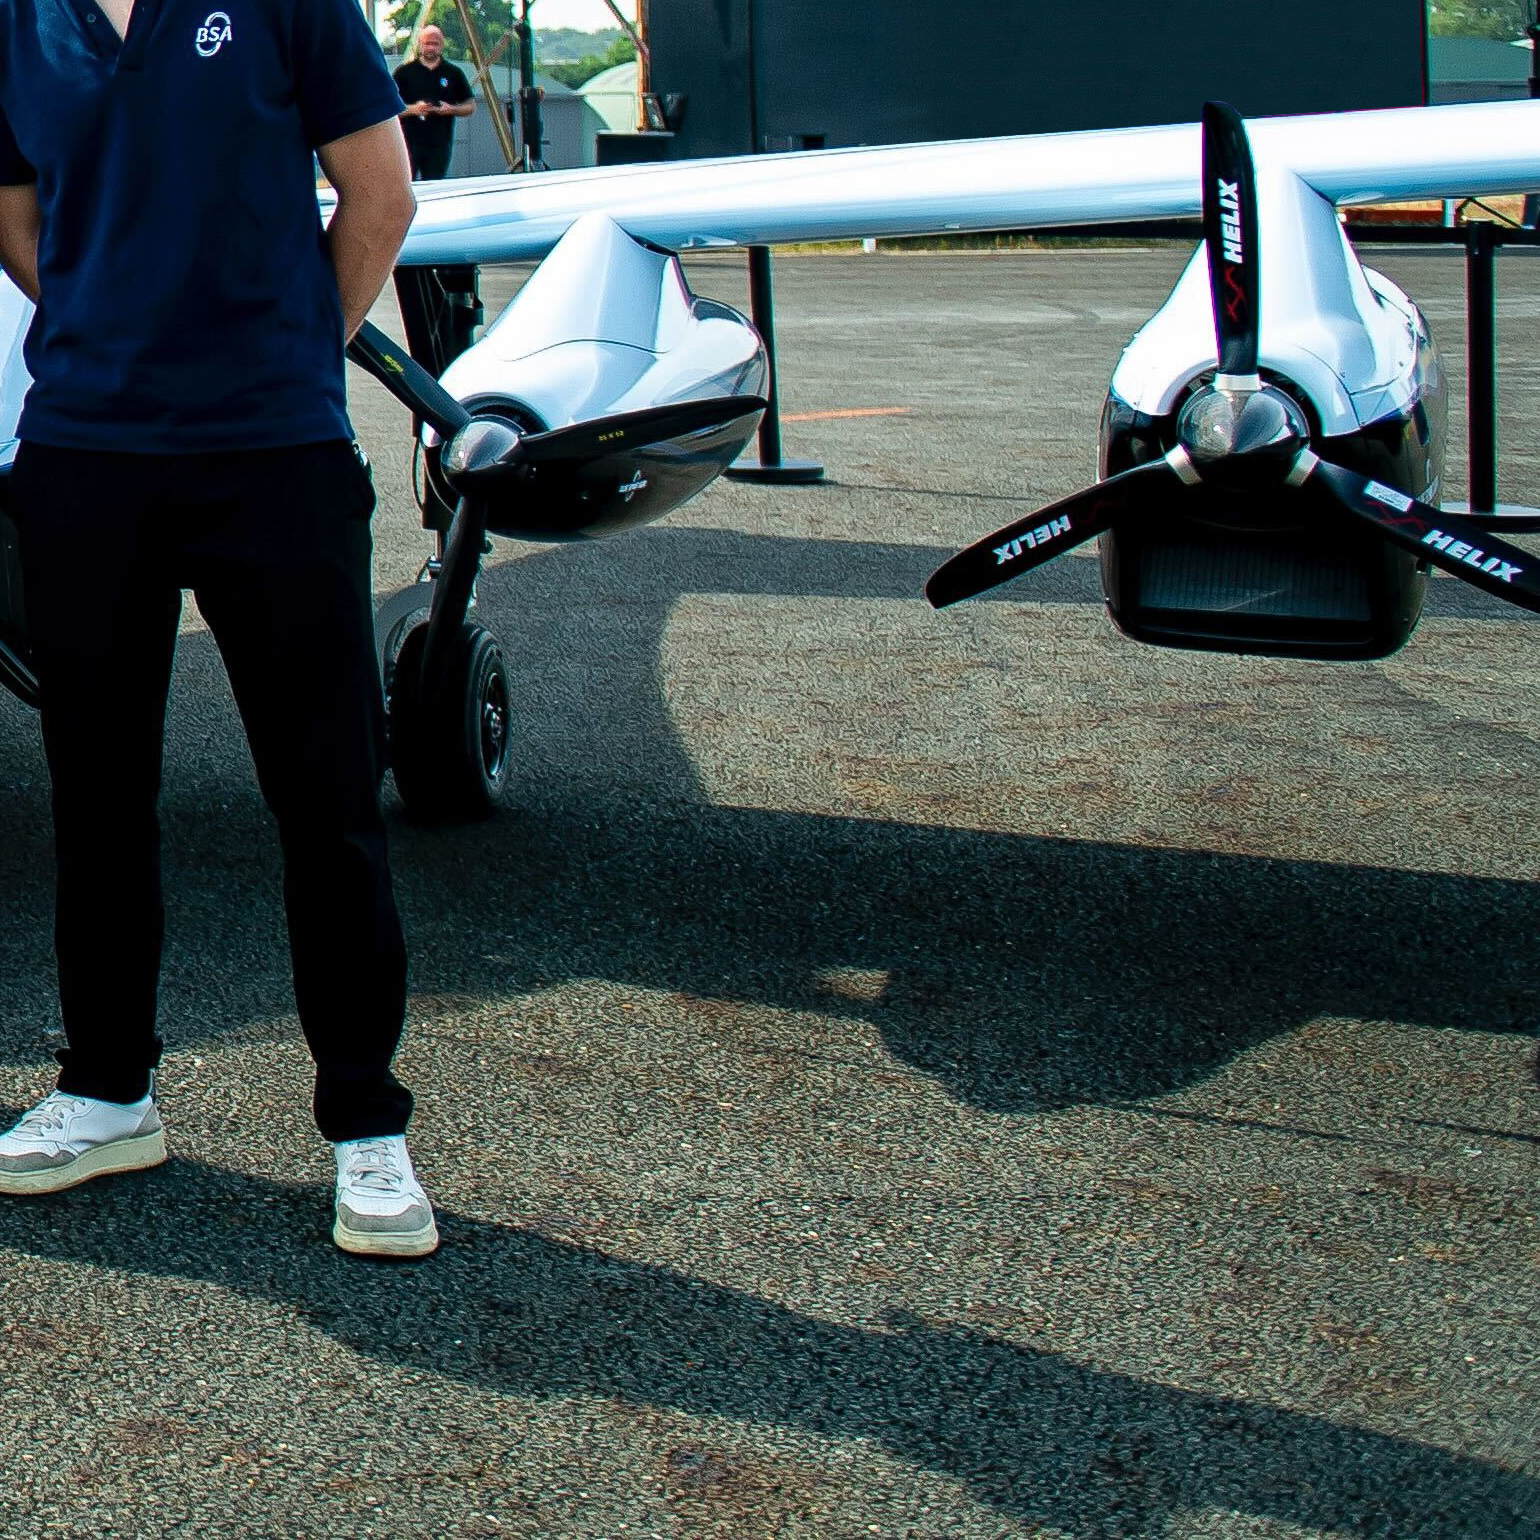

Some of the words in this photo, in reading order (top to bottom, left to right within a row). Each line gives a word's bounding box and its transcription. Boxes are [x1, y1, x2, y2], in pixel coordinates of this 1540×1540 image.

[195, 25, 233, 43] BSA
[1217, 178, 1243, 264] HELIX
[992, 515, 1072, 565] HELIX
[1421, 529, 1524, 584] HELIX
